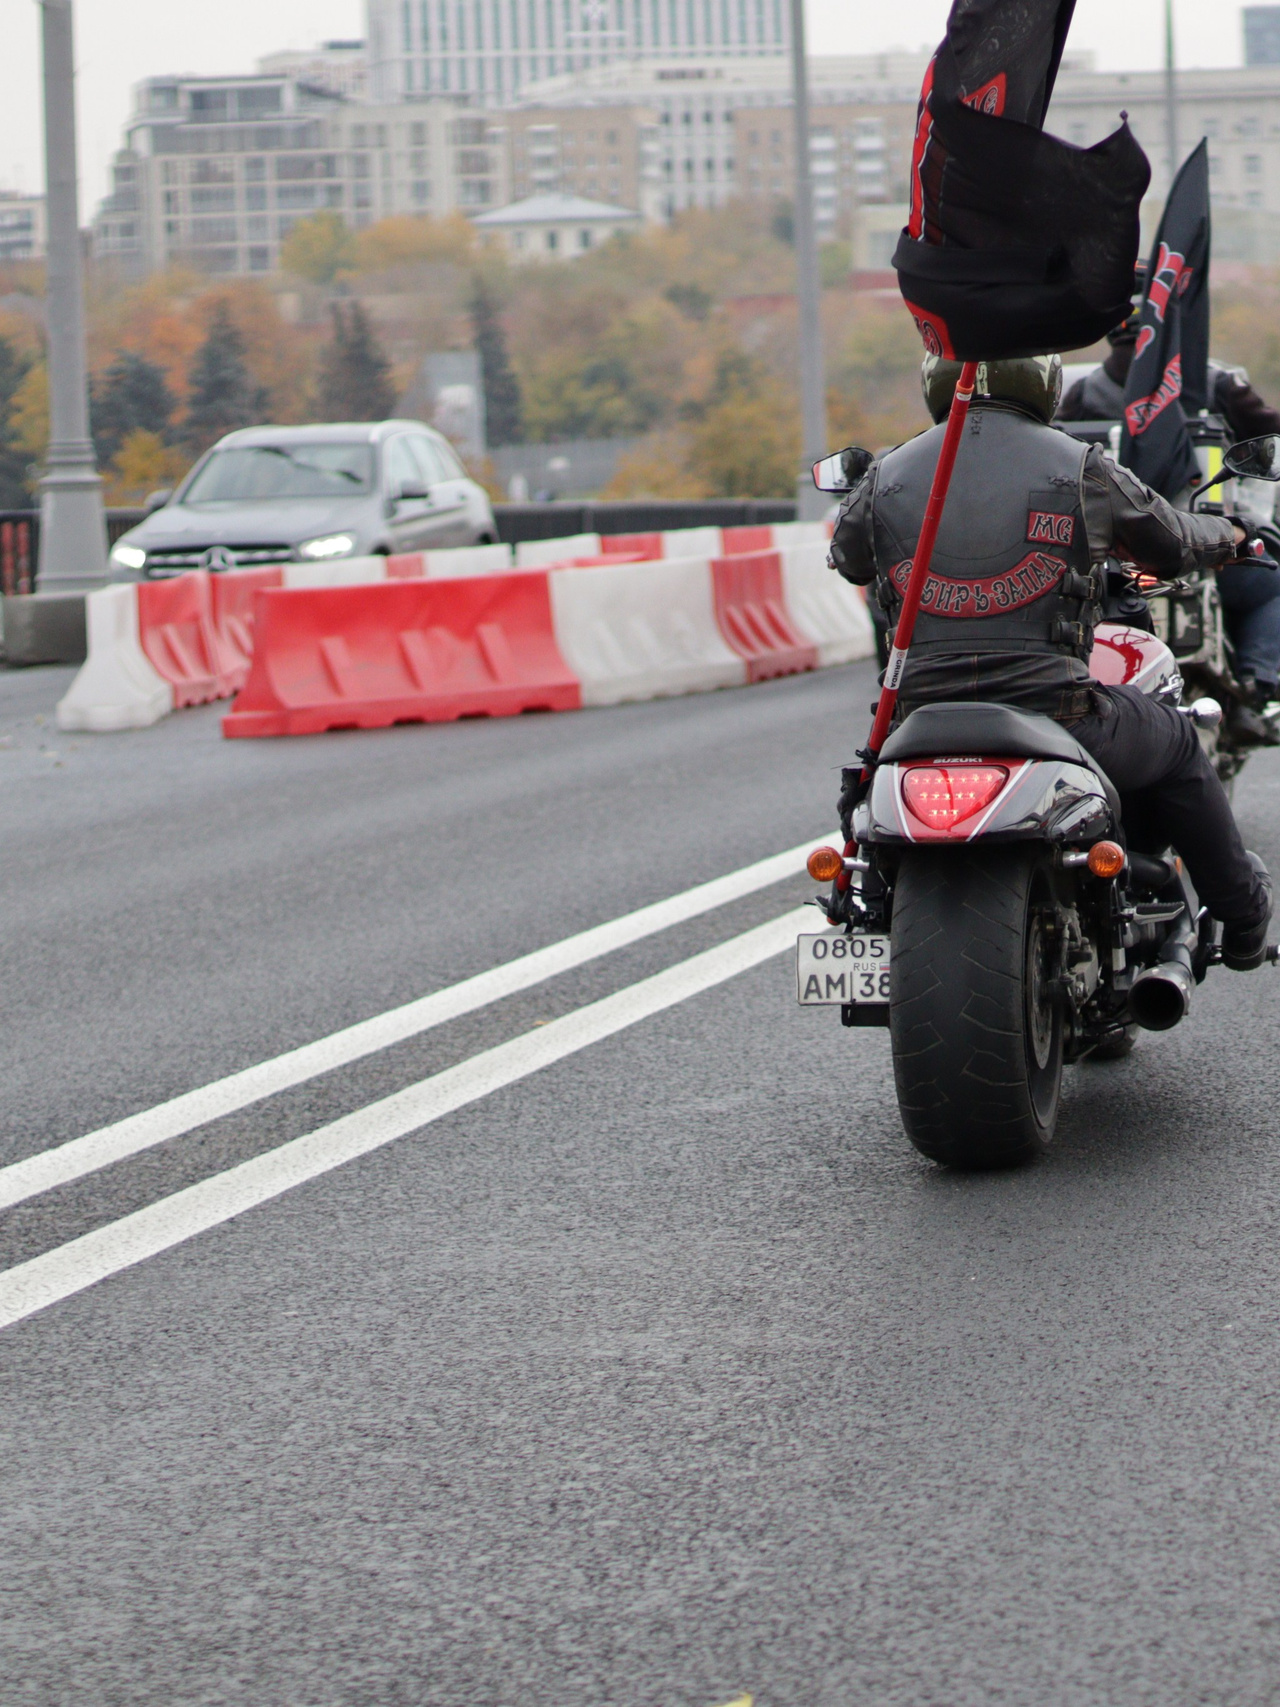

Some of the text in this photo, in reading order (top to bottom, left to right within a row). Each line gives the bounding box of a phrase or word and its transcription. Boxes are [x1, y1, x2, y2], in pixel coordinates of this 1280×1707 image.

[812, 938, 884, 959] 0805
[853, 962, 877, 971] RUS
[860, 972, 890, 998] 38
